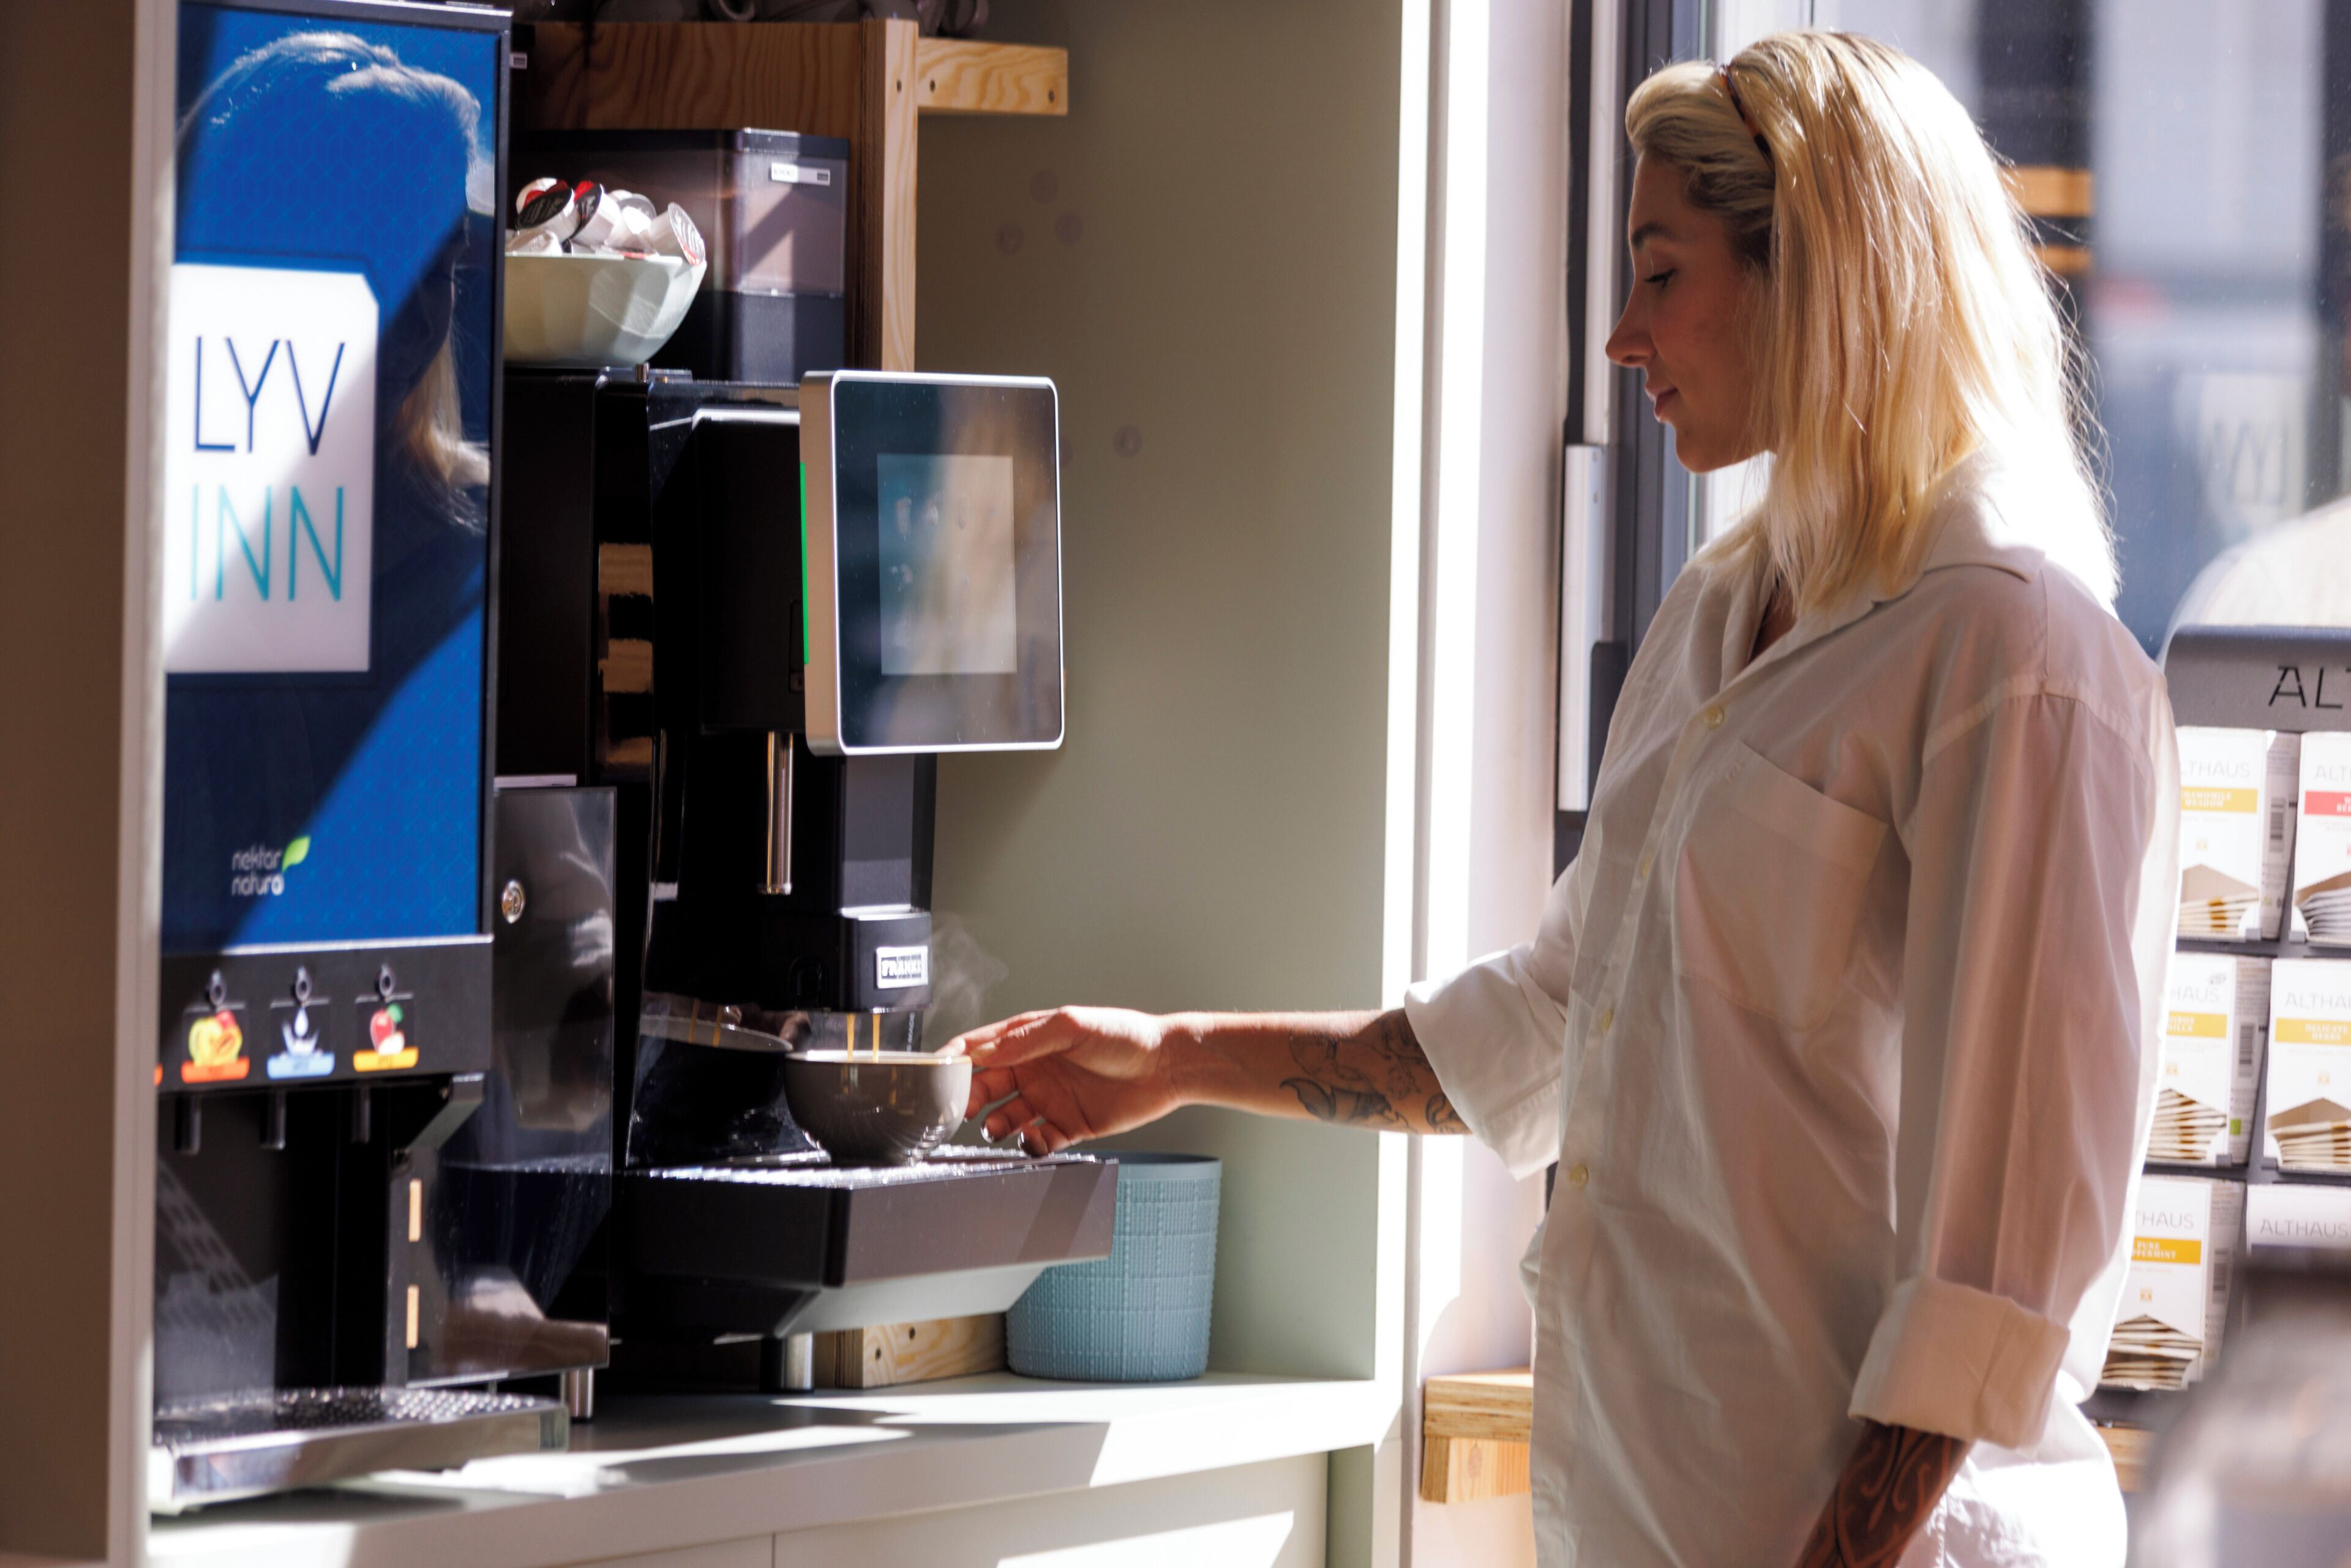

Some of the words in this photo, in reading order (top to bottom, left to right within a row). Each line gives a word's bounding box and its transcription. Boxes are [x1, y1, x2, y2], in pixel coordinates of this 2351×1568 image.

[194, 336, 345, 456] LYV
[190, 484, 344, 602] INN
[2268, 665, 2351, 709] AL
[231, 843, 282, 870] nektar
[231, 871, 285, 896] natura
[2285, 992, 2351, 1011] ALTHA
[2260, 1218, 2349, 1239] ALTHAUS
